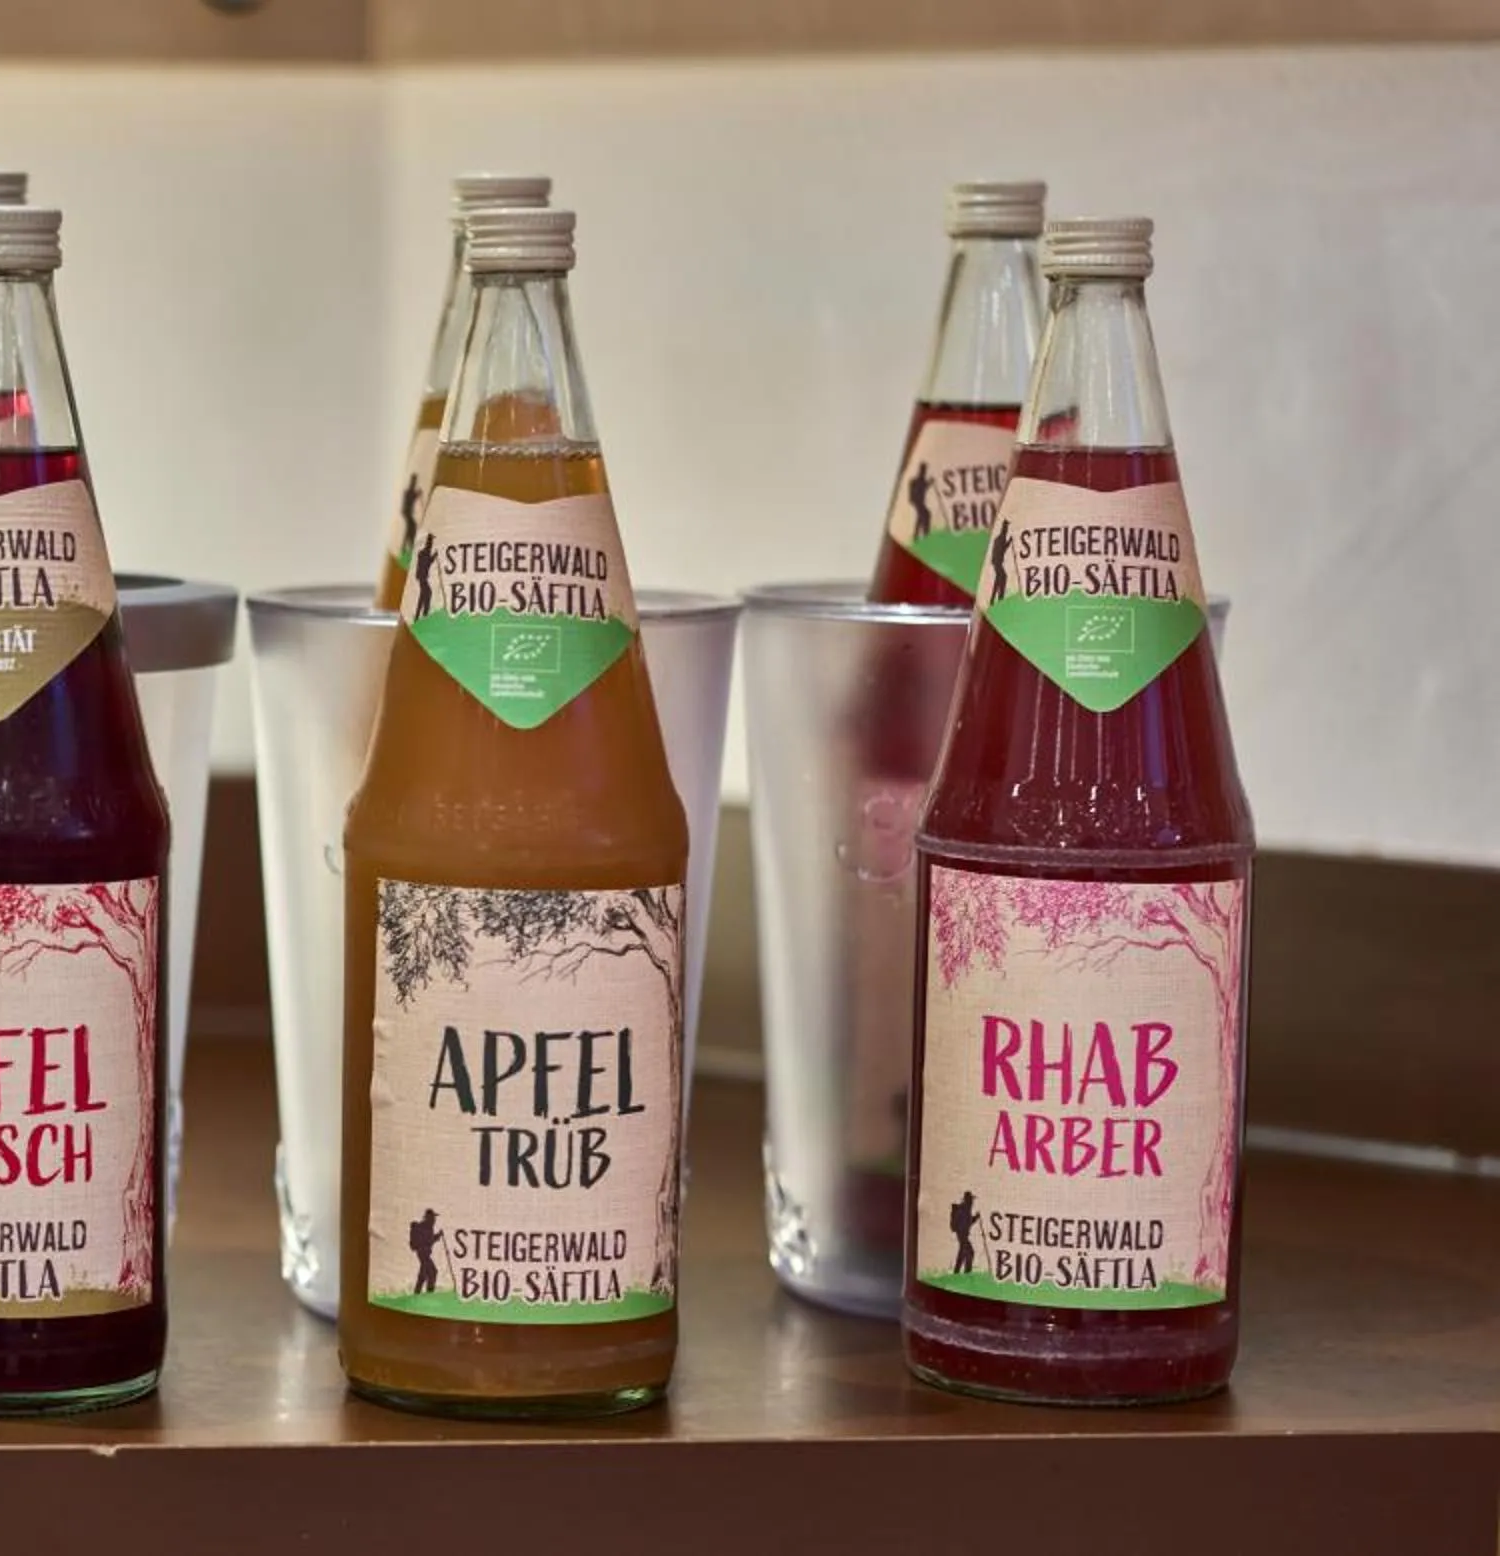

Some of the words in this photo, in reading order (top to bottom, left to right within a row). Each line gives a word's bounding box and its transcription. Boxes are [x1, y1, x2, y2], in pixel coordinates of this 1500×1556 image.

[444, 541, 608, 581] STEIGERWALD
[1019, 525, 1181, 563] STEIGERWALD
[450, 576, 607, 620] BIO-SÄFTLA
[1024, 559, 1180, 602] BIO-SÄFTLA
[428, 1025, 646, 1120] APFEL
[981, 1015, 1180, 1109] RHAB
[470, 1116, 612, 1190] TRÜB
[988, 1109, 1163, 1179] ARBER
[452, 1228, 628, 1264] STEIGERWALD
[988, 1211, 1164, 1250] STEIGERWALD
[460, 1265, 622, 1304] BIO-SÄFTLA
[994, 1248, 1158, 1290] BIO-SÄFTLA
